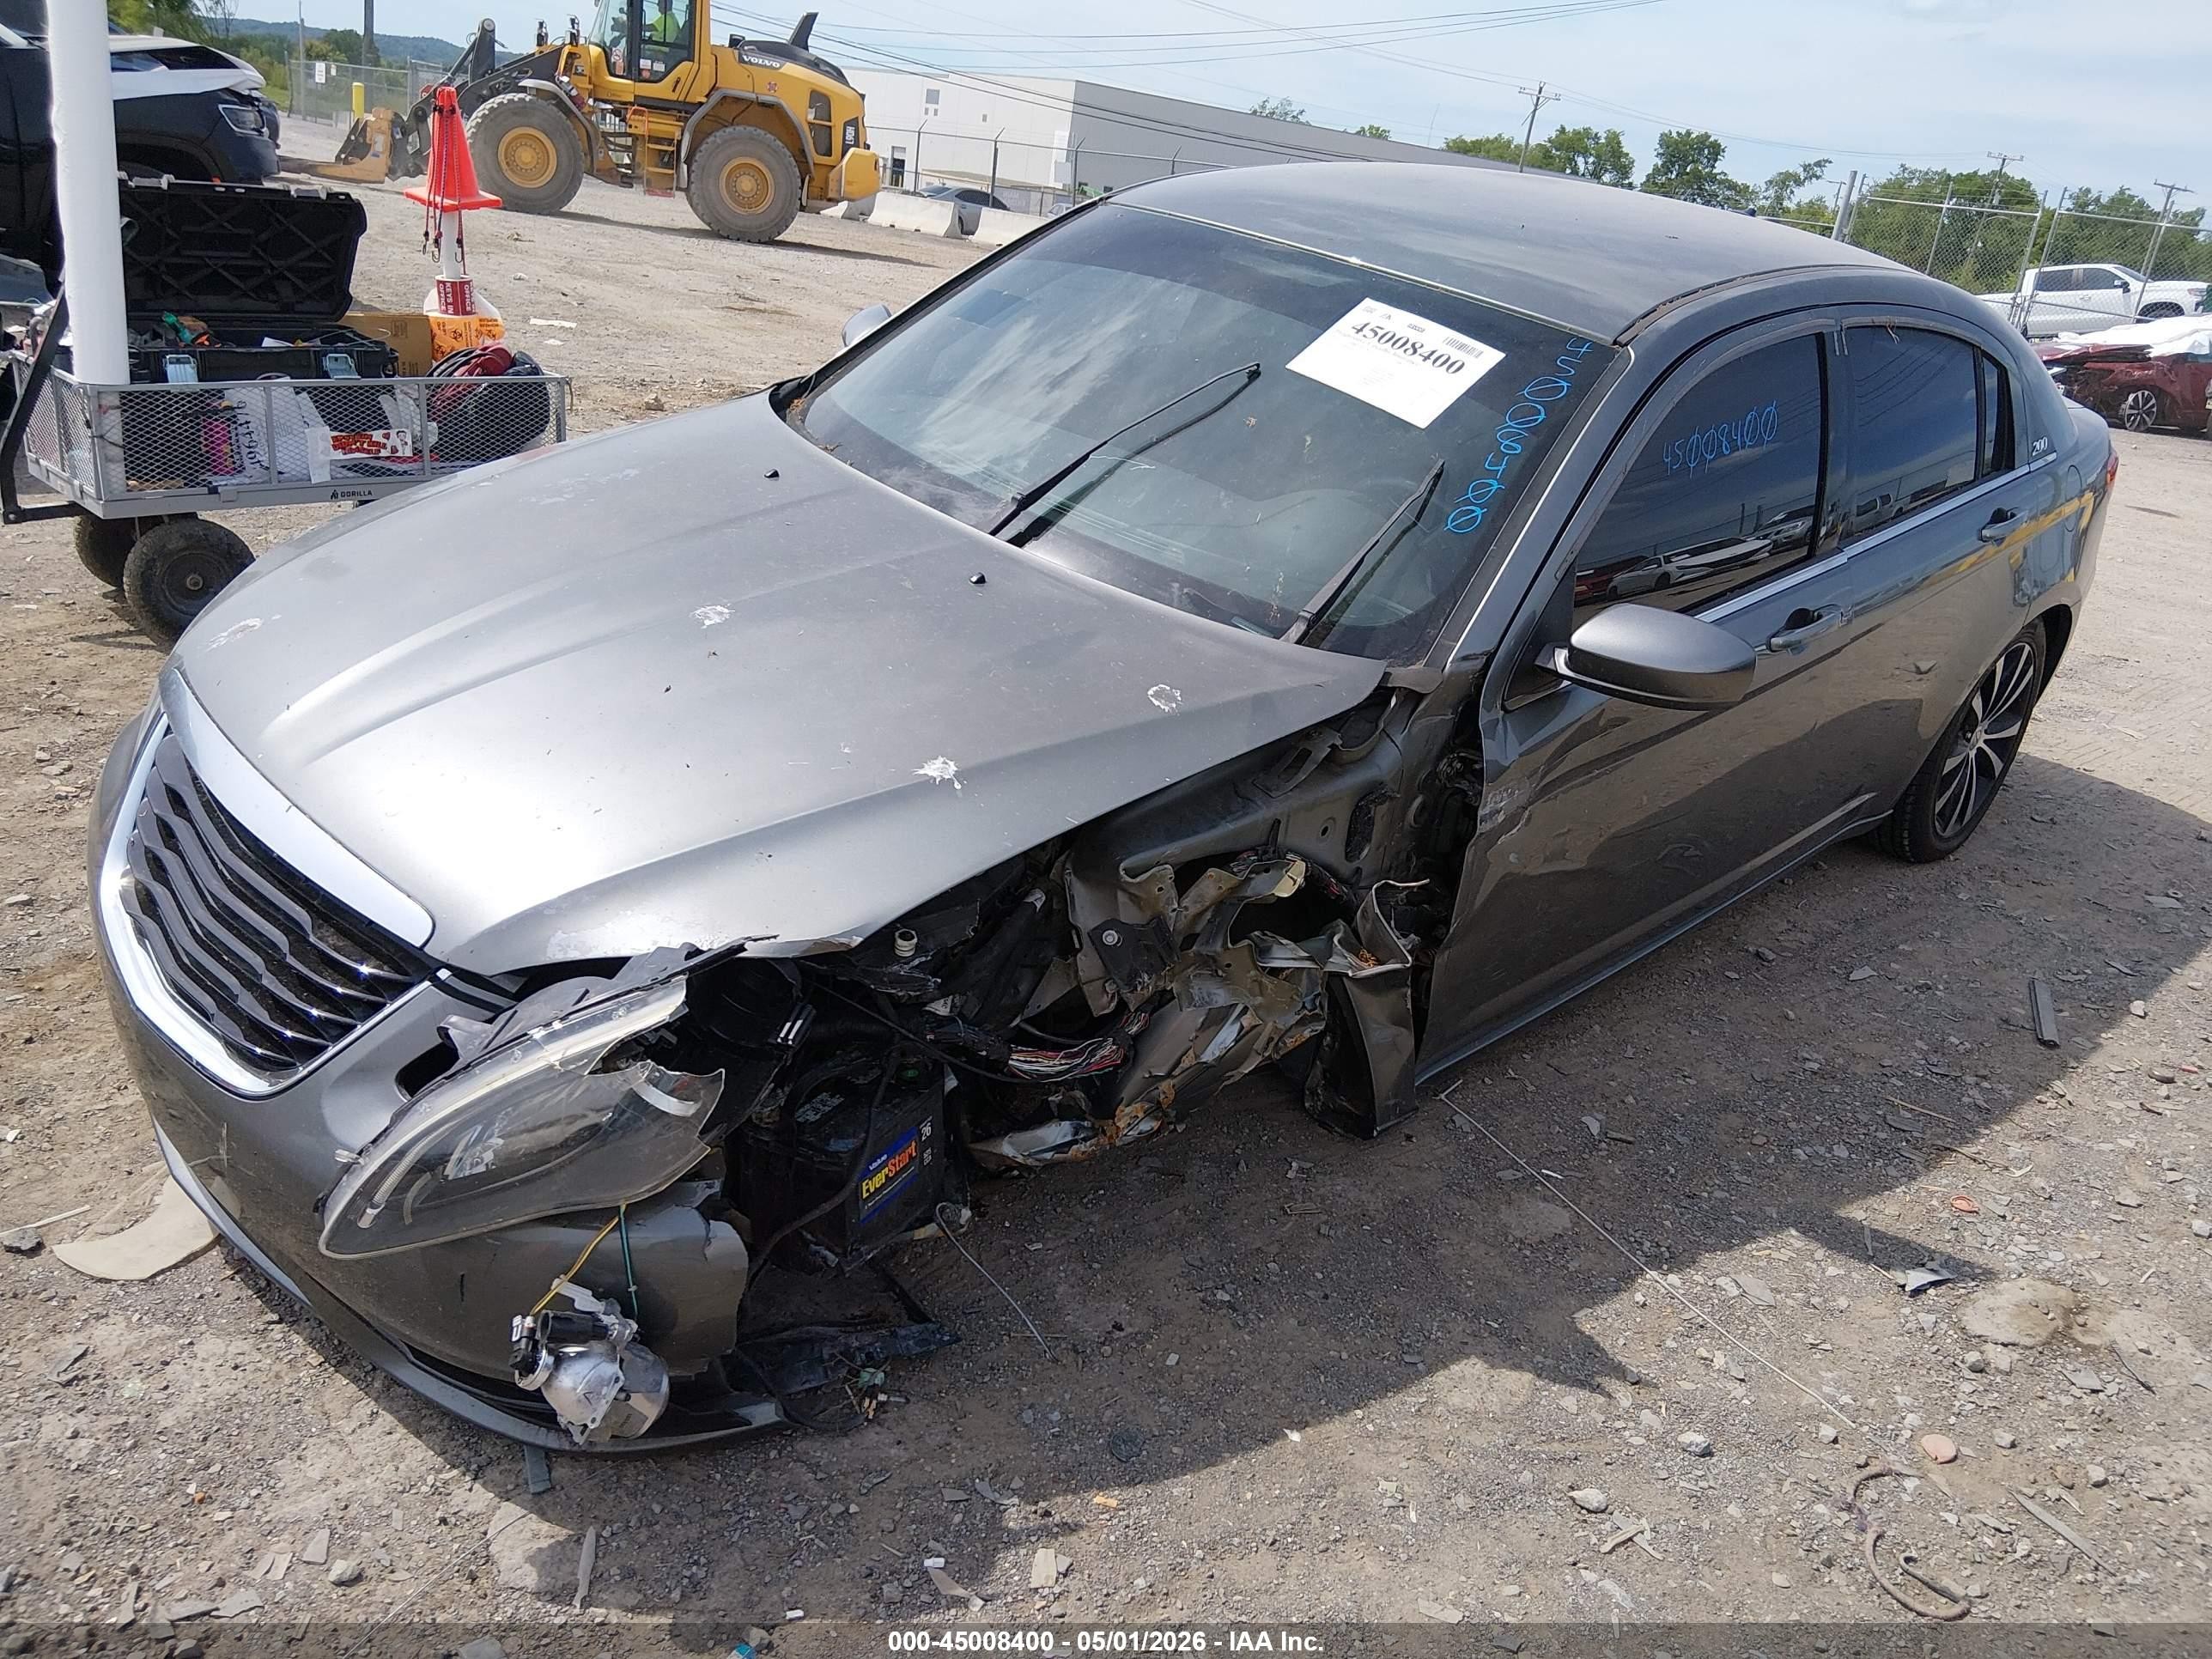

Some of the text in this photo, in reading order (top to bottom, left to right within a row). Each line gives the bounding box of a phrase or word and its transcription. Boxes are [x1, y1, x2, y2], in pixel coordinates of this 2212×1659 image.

[742, 55, 781, 69] VOLVO
[445, 283, 454, 314] KEYS IN
[1351, 321, 1466, 374] 45008400
[2032, 436, 2048, 457] 200
[340, 489, 373, 498] GORILLA
[921, 1122, 932, 1142] 26
[861, 1139, 917, 1200] EverStart
